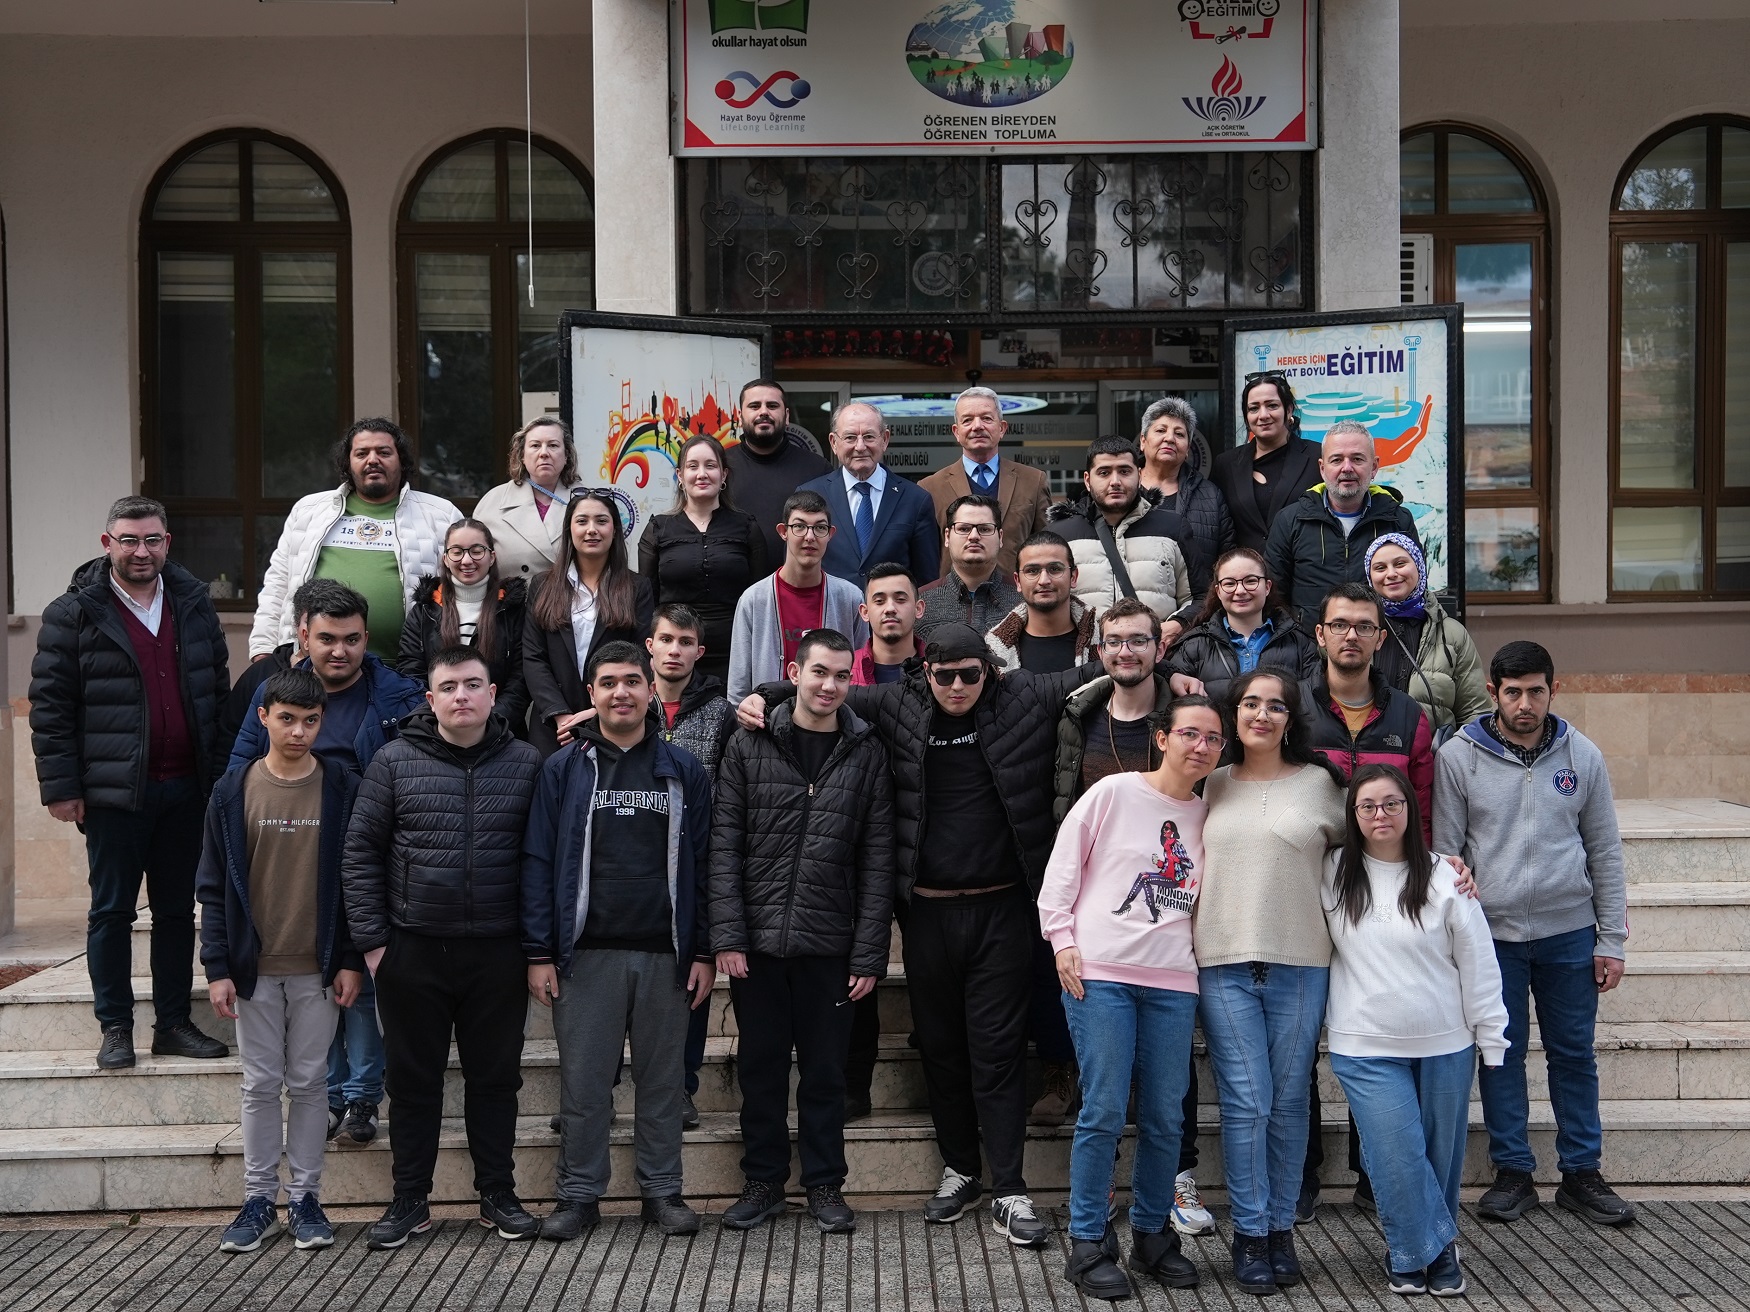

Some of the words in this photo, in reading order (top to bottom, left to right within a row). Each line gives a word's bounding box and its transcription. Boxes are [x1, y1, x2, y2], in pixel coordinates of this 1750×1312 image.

[1206, 3, 1256, 17] EĞİTİMİ
[711, 35, 748, 48] okullar
[749, 36, 779, 50] hayat
[780, 35, 807, 47] olsun
[720, 114, 744, 123] Hayat
[746, 114, 767, 123] Boyu
[769, 112, 806, 123] Öğrenme
[923, 115, 987, 127] ÖĞRENEN
[991, 113, 1057, 126] BİREYDEN
[720, 123, 760, 132] LifeLong
[764, 123, 805, 132] Learning
[923, 128, 987, 140] ÖĞRENEN
[994, 129, 1057, 140] TOPLUMA
[1206, 124, 1220, 132] AÇIK
[1277, 354, 1308, 366] HERKES
[1309, 352, 1326, 366] İÇİN
[1326, 343, 1405, 377] EĞİTİM
[1280, 367, 1298, 378] YAT
[1300, 366, 1326, 377] BOYU
[895, 424, 913, 436] HALK
[914, 421, 936, 436] EĞİTİM
[340, 526, 355, 535] 18
[593, 789, 670, 816] ALIFORNIA
[615, 807, 635, 816] 1998
[258, 819, 283, 827] TOMMY
[1157, 885, 1194, 903] MONDAY
[1155, 894, 1194, 914] MORNIN
